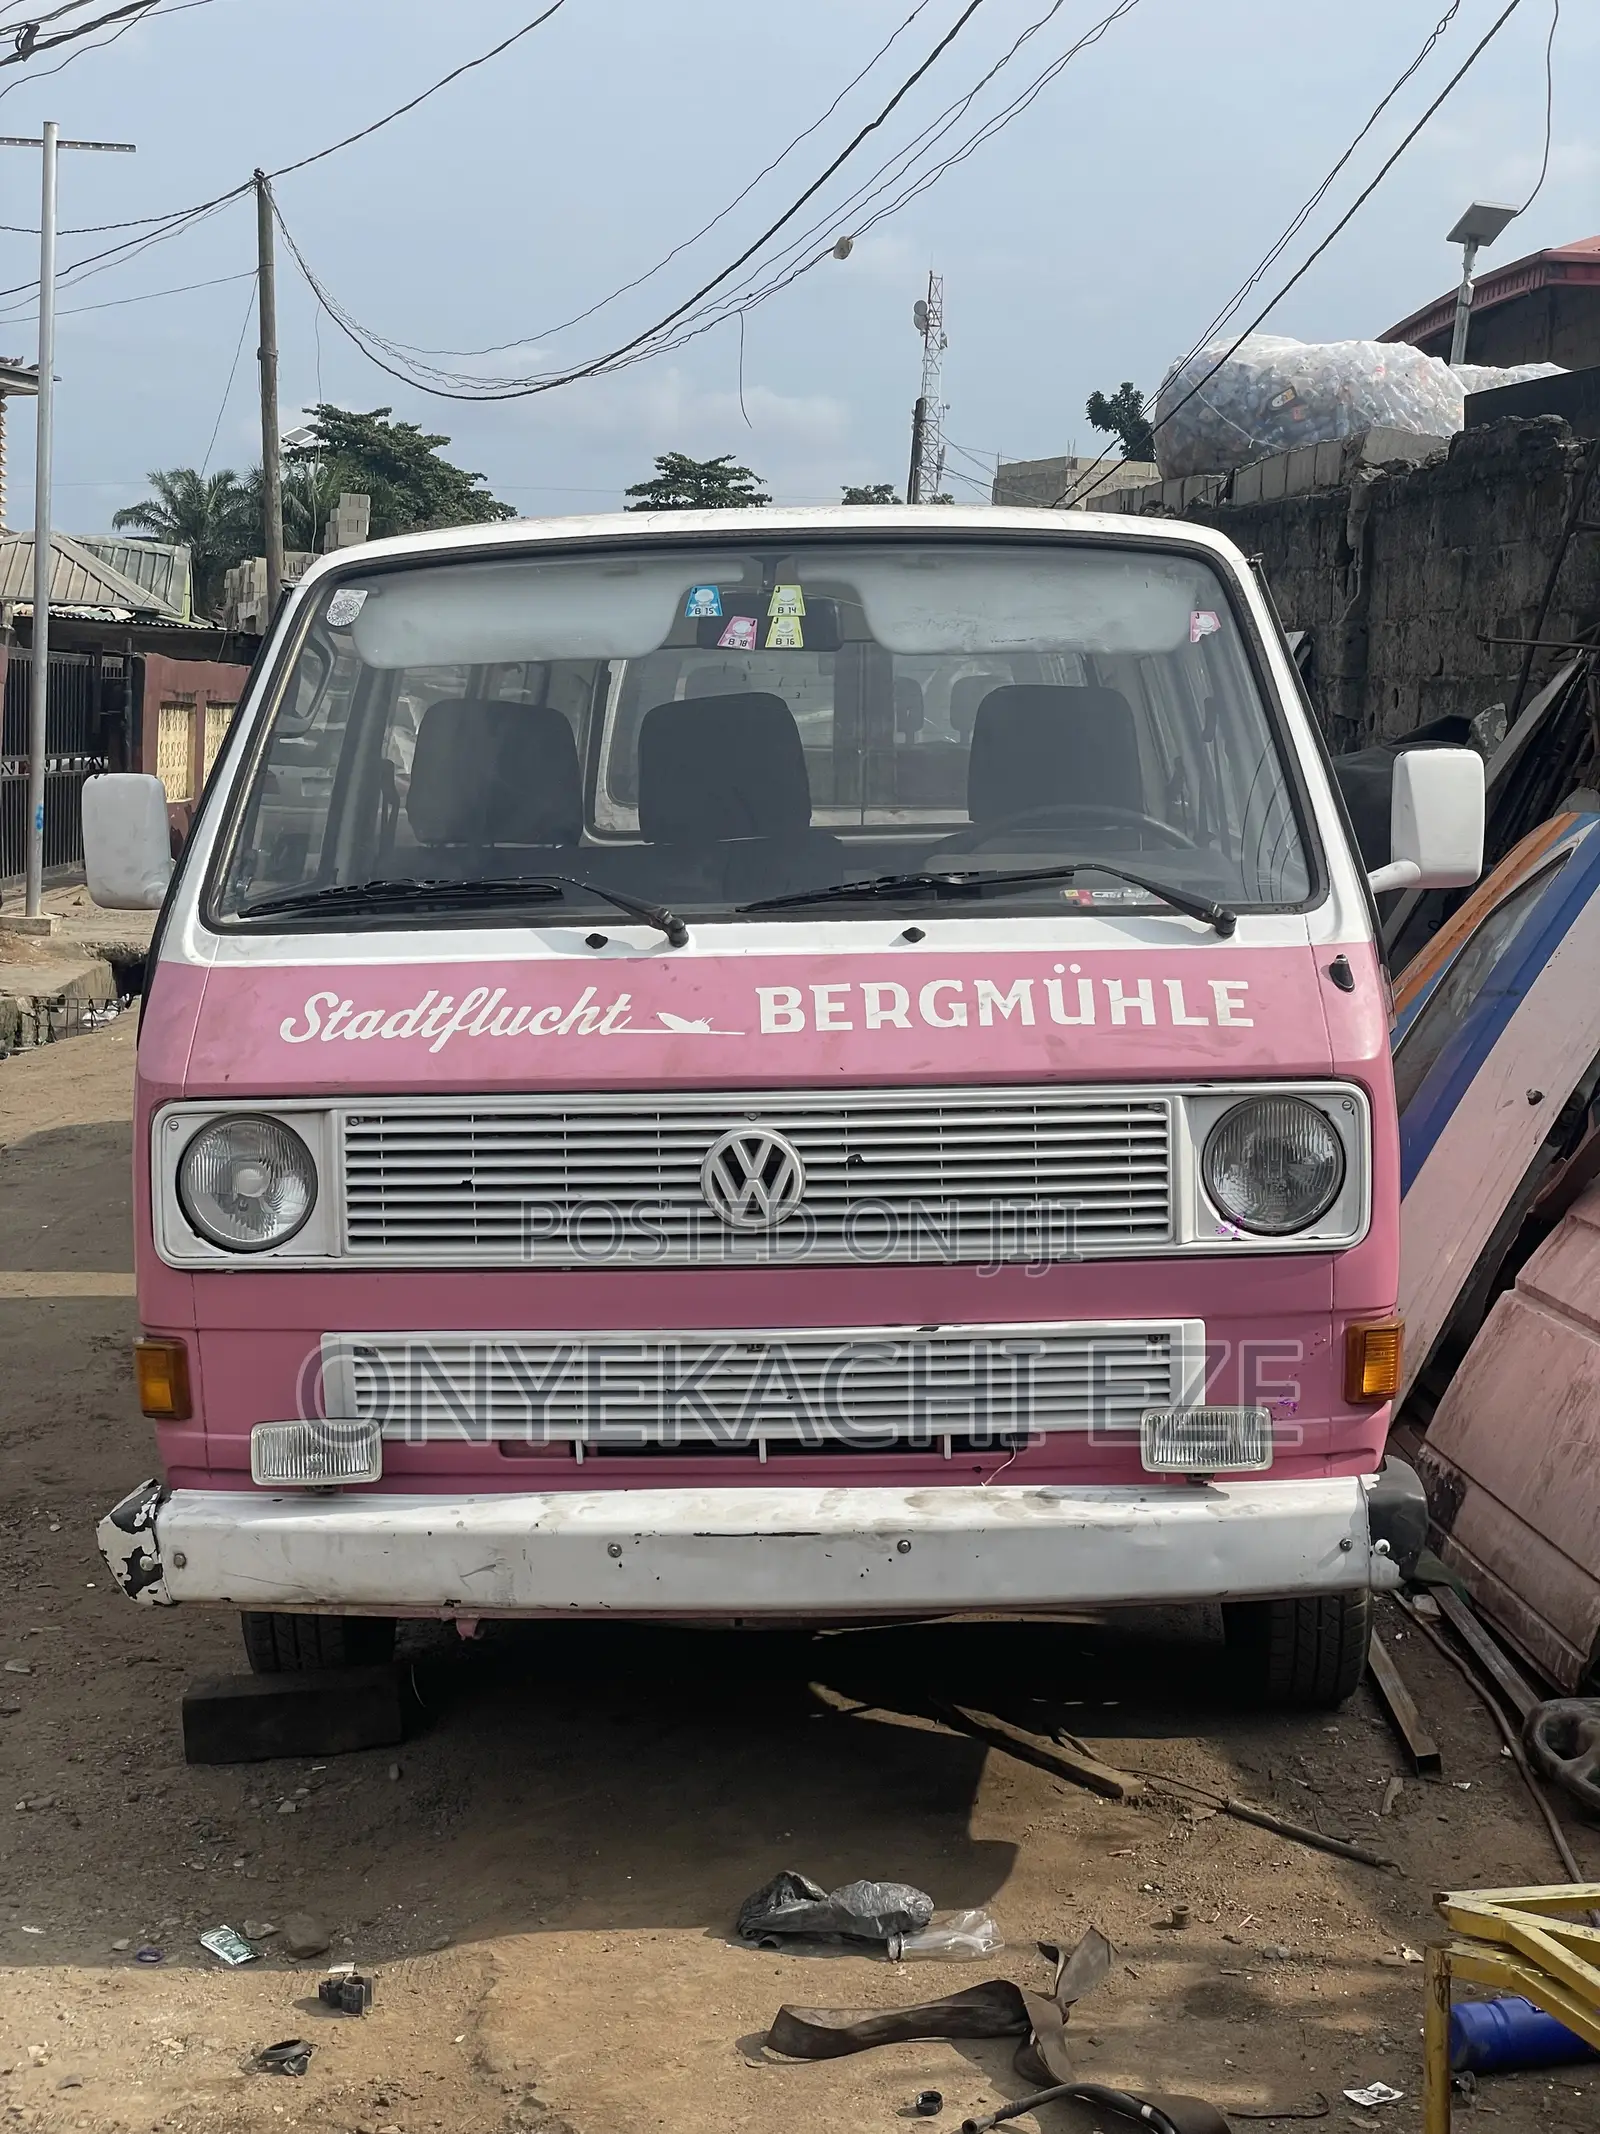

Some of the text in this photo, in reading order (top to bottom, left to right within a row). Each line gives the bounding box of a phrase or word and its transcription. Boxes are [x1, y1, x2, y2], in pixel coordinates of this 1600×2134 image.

[786, 638, 795, 646] 16
[279, 963, 1254, 1053] Stadtflucht BERGMÜHLE
[702, 1129, 805, 1228] VW
